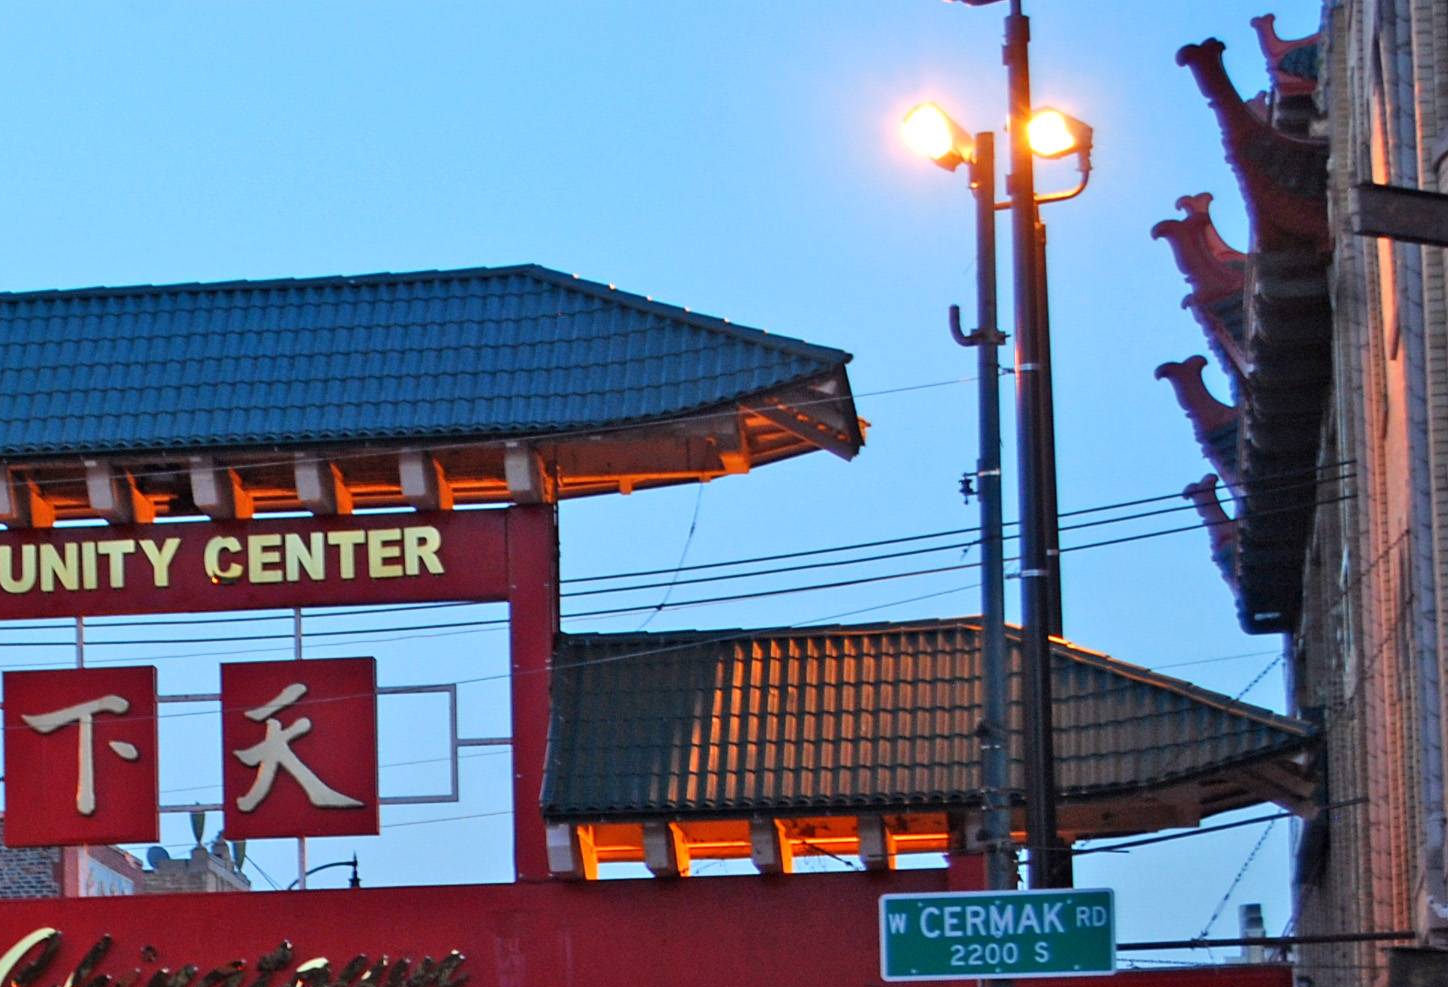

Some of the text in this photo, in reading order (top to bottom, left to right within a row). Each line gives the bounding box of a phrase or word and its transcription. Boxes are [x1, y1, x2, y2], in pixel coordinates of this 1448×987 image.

[204, 526, 445, 584] CENTER
[20, 695, 140, 816] 下
[234, 683, 366, 812] 天
[888, 903, 1107, 938] W CERMAK RD
[950, 942, 1049, 966] 2200 S
